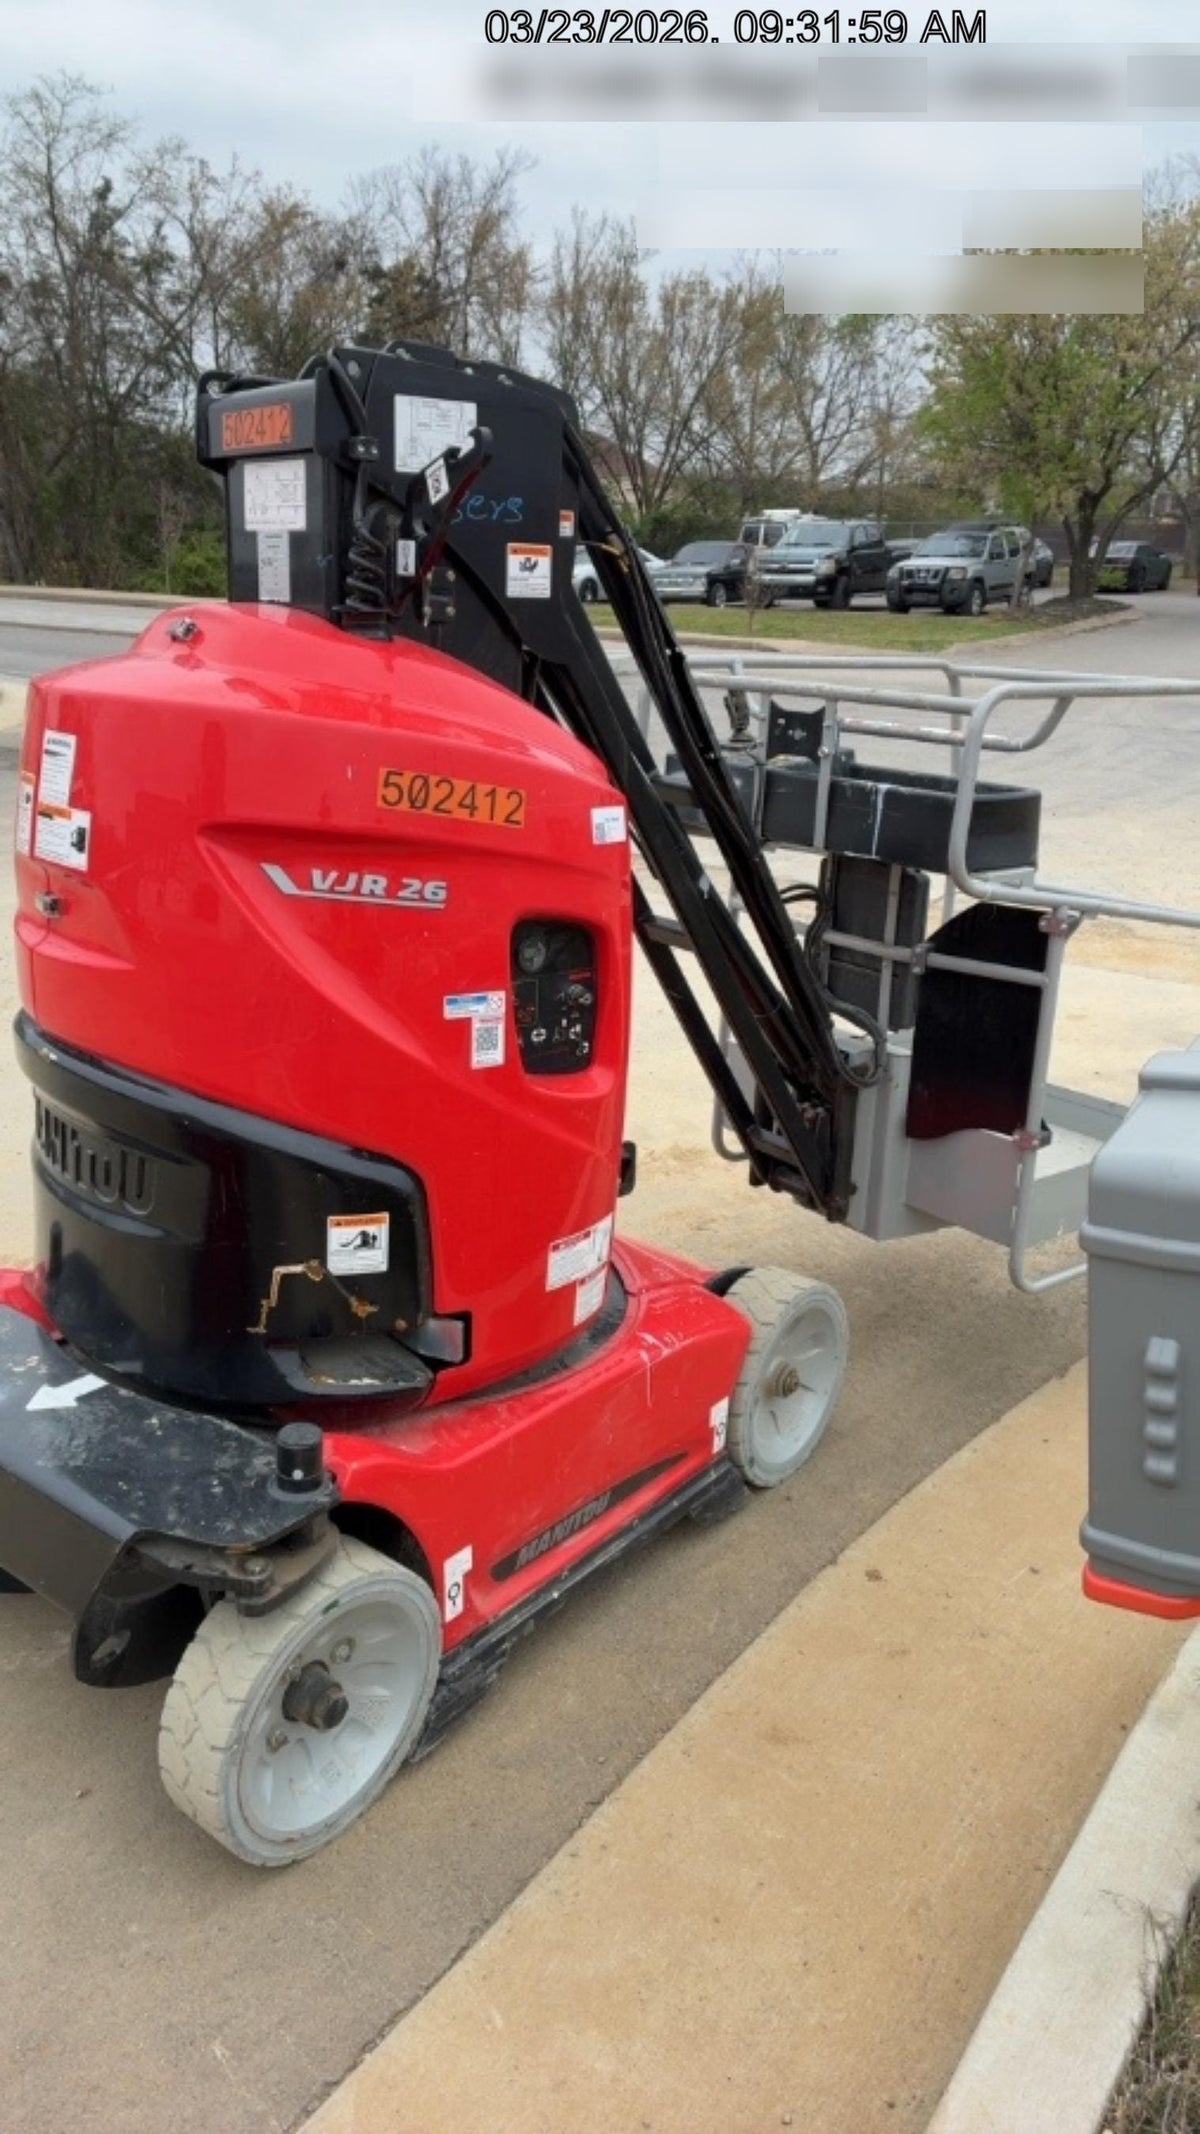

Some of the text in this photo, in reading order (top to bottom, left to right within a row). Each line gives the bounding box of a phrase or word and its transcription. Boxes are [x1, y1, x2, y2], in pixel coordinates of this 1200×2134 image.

[225, 405, 290, 447] 502412
[381, 770, 524, 826] 502412
[311, 868, 447, 902] VJR 26
[513, 1491, 611, 1571] MANITOU
